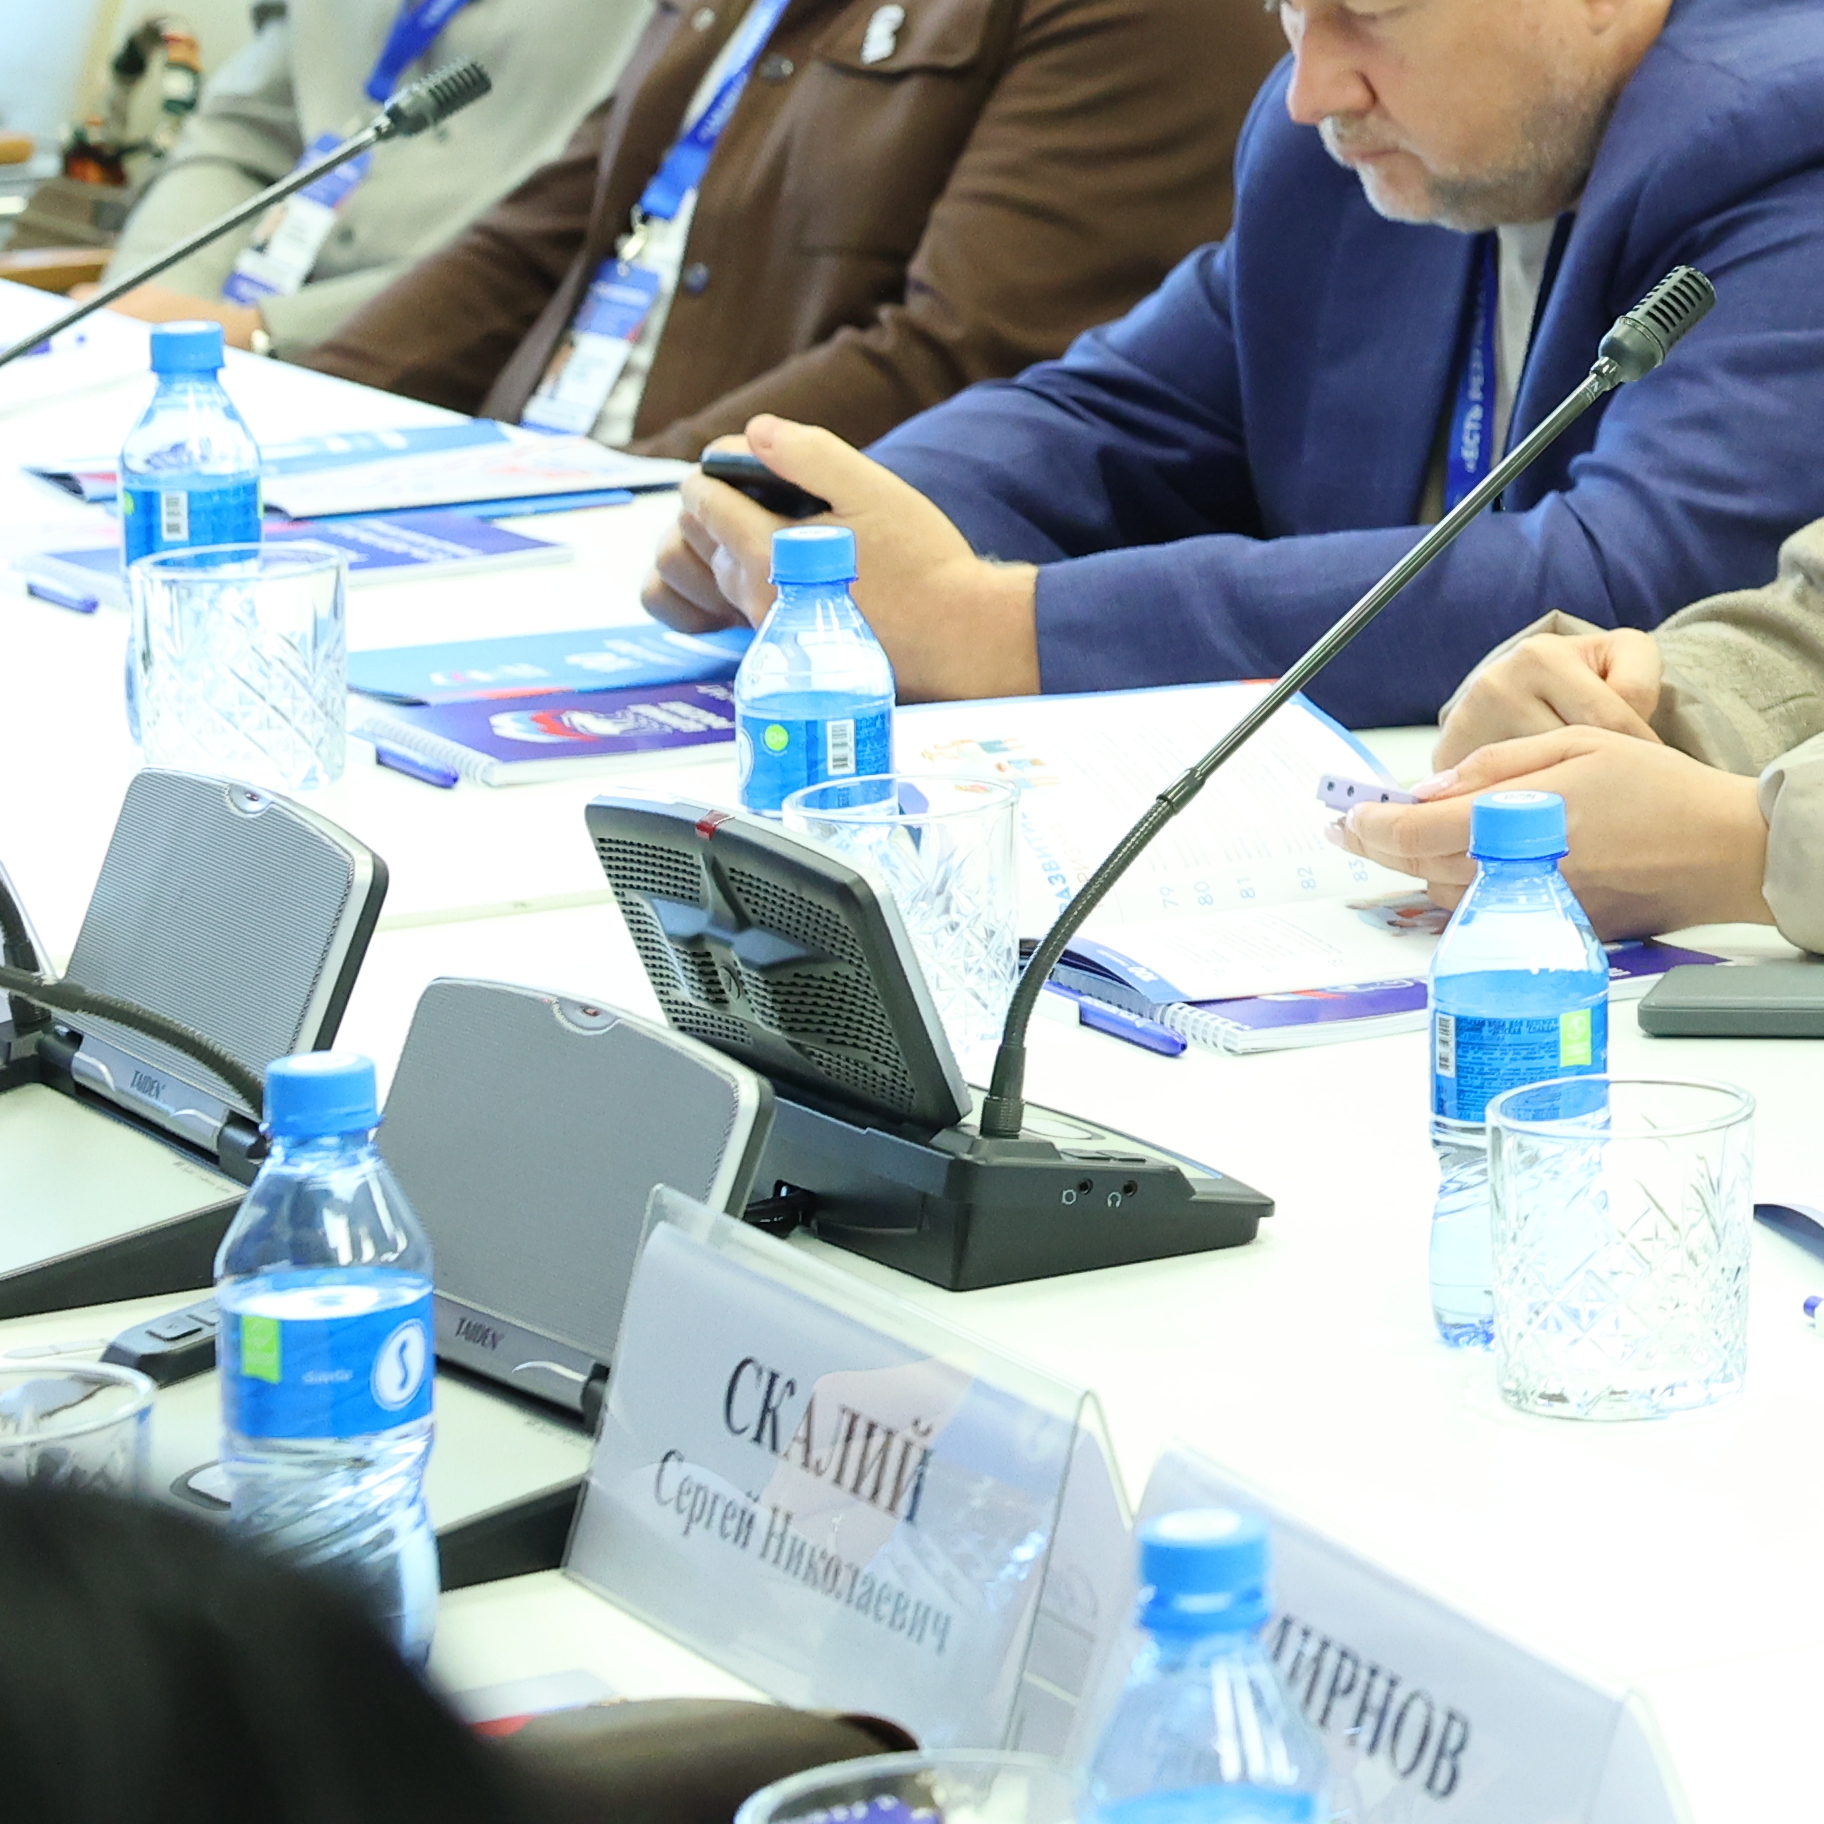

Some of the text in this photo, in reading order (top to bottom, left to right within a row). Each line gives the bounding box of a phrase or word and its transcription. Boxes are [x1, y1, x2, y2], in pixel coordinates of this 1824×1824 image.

[1194, 880, 1215, 907] 80
[1297, 866, 1317, 891] 82
[723, 1355, 936, 1526] СКАЛИЙ
[653, 1448, 953, 1656] Сергей Николаевич
